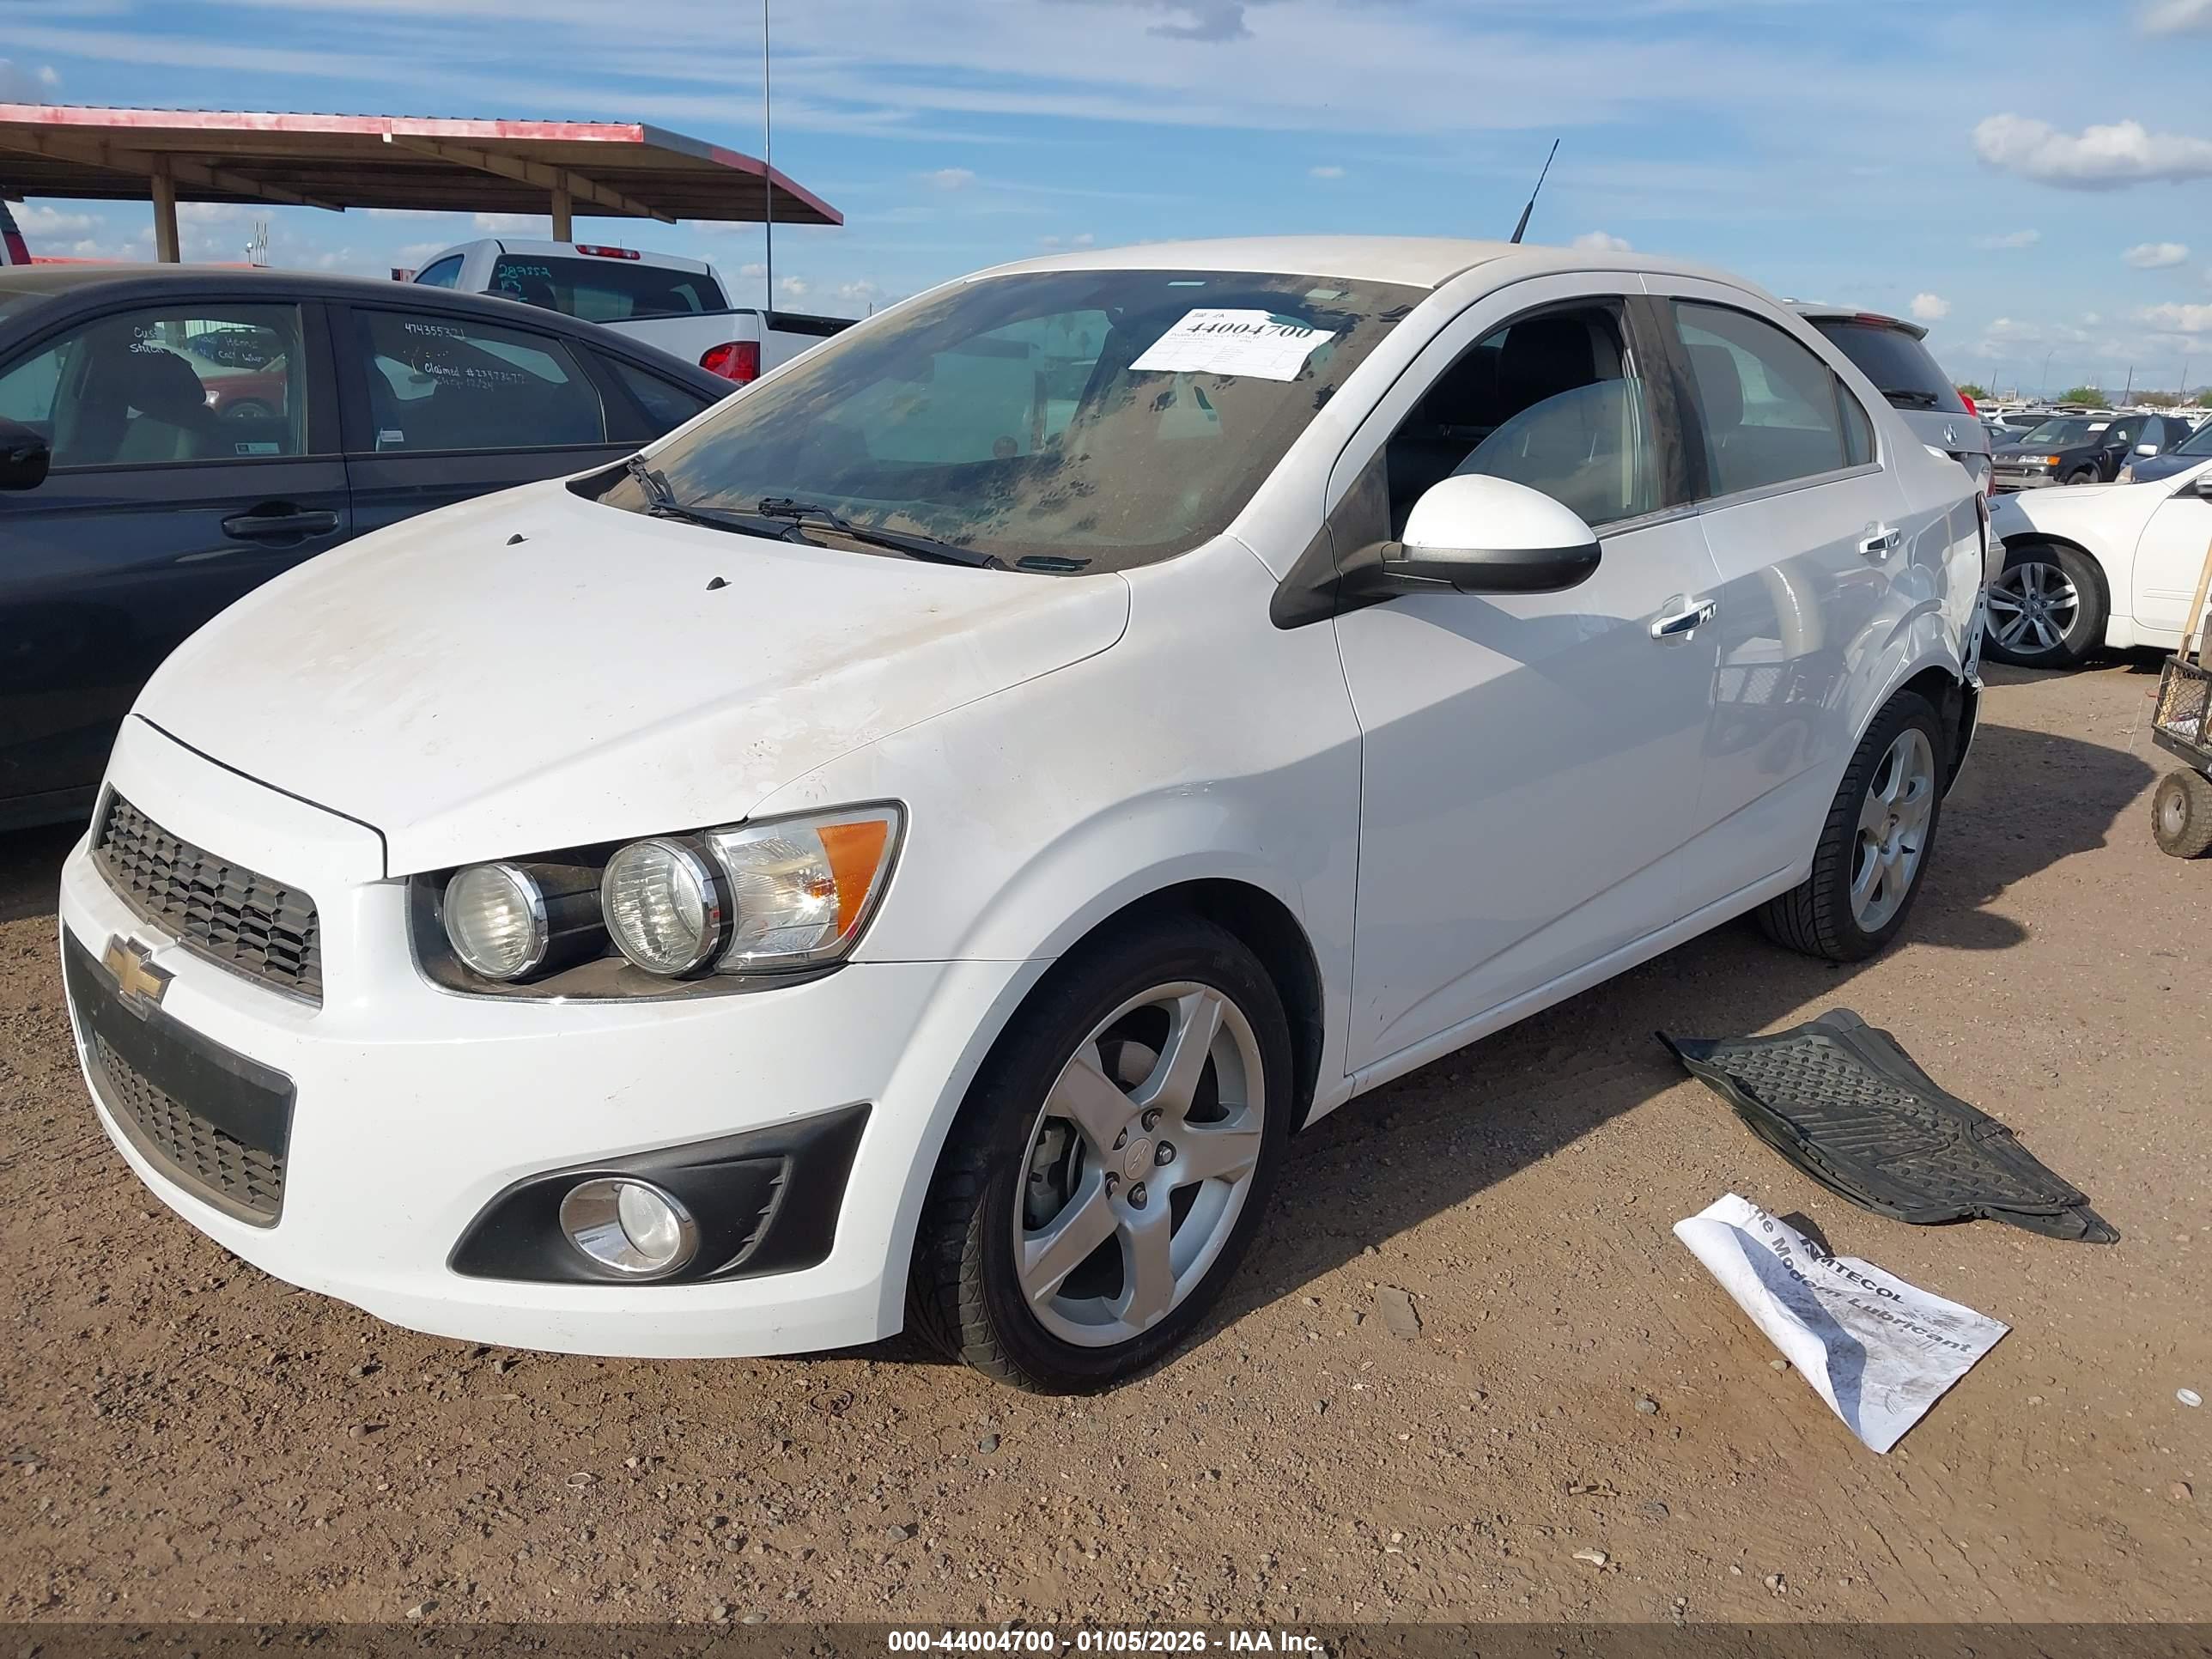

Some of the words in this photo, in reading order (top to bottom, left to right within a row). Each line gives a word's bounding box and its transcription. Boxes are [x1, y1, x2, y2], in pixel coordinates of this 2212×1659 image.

[1187, 321, 1315, 339] 44004700
[424, 362, 460, 377] Claimed
[1771, 1237, 1842, 1297] Modern
[1847, 1297, 1974, 1352] Lubricant
